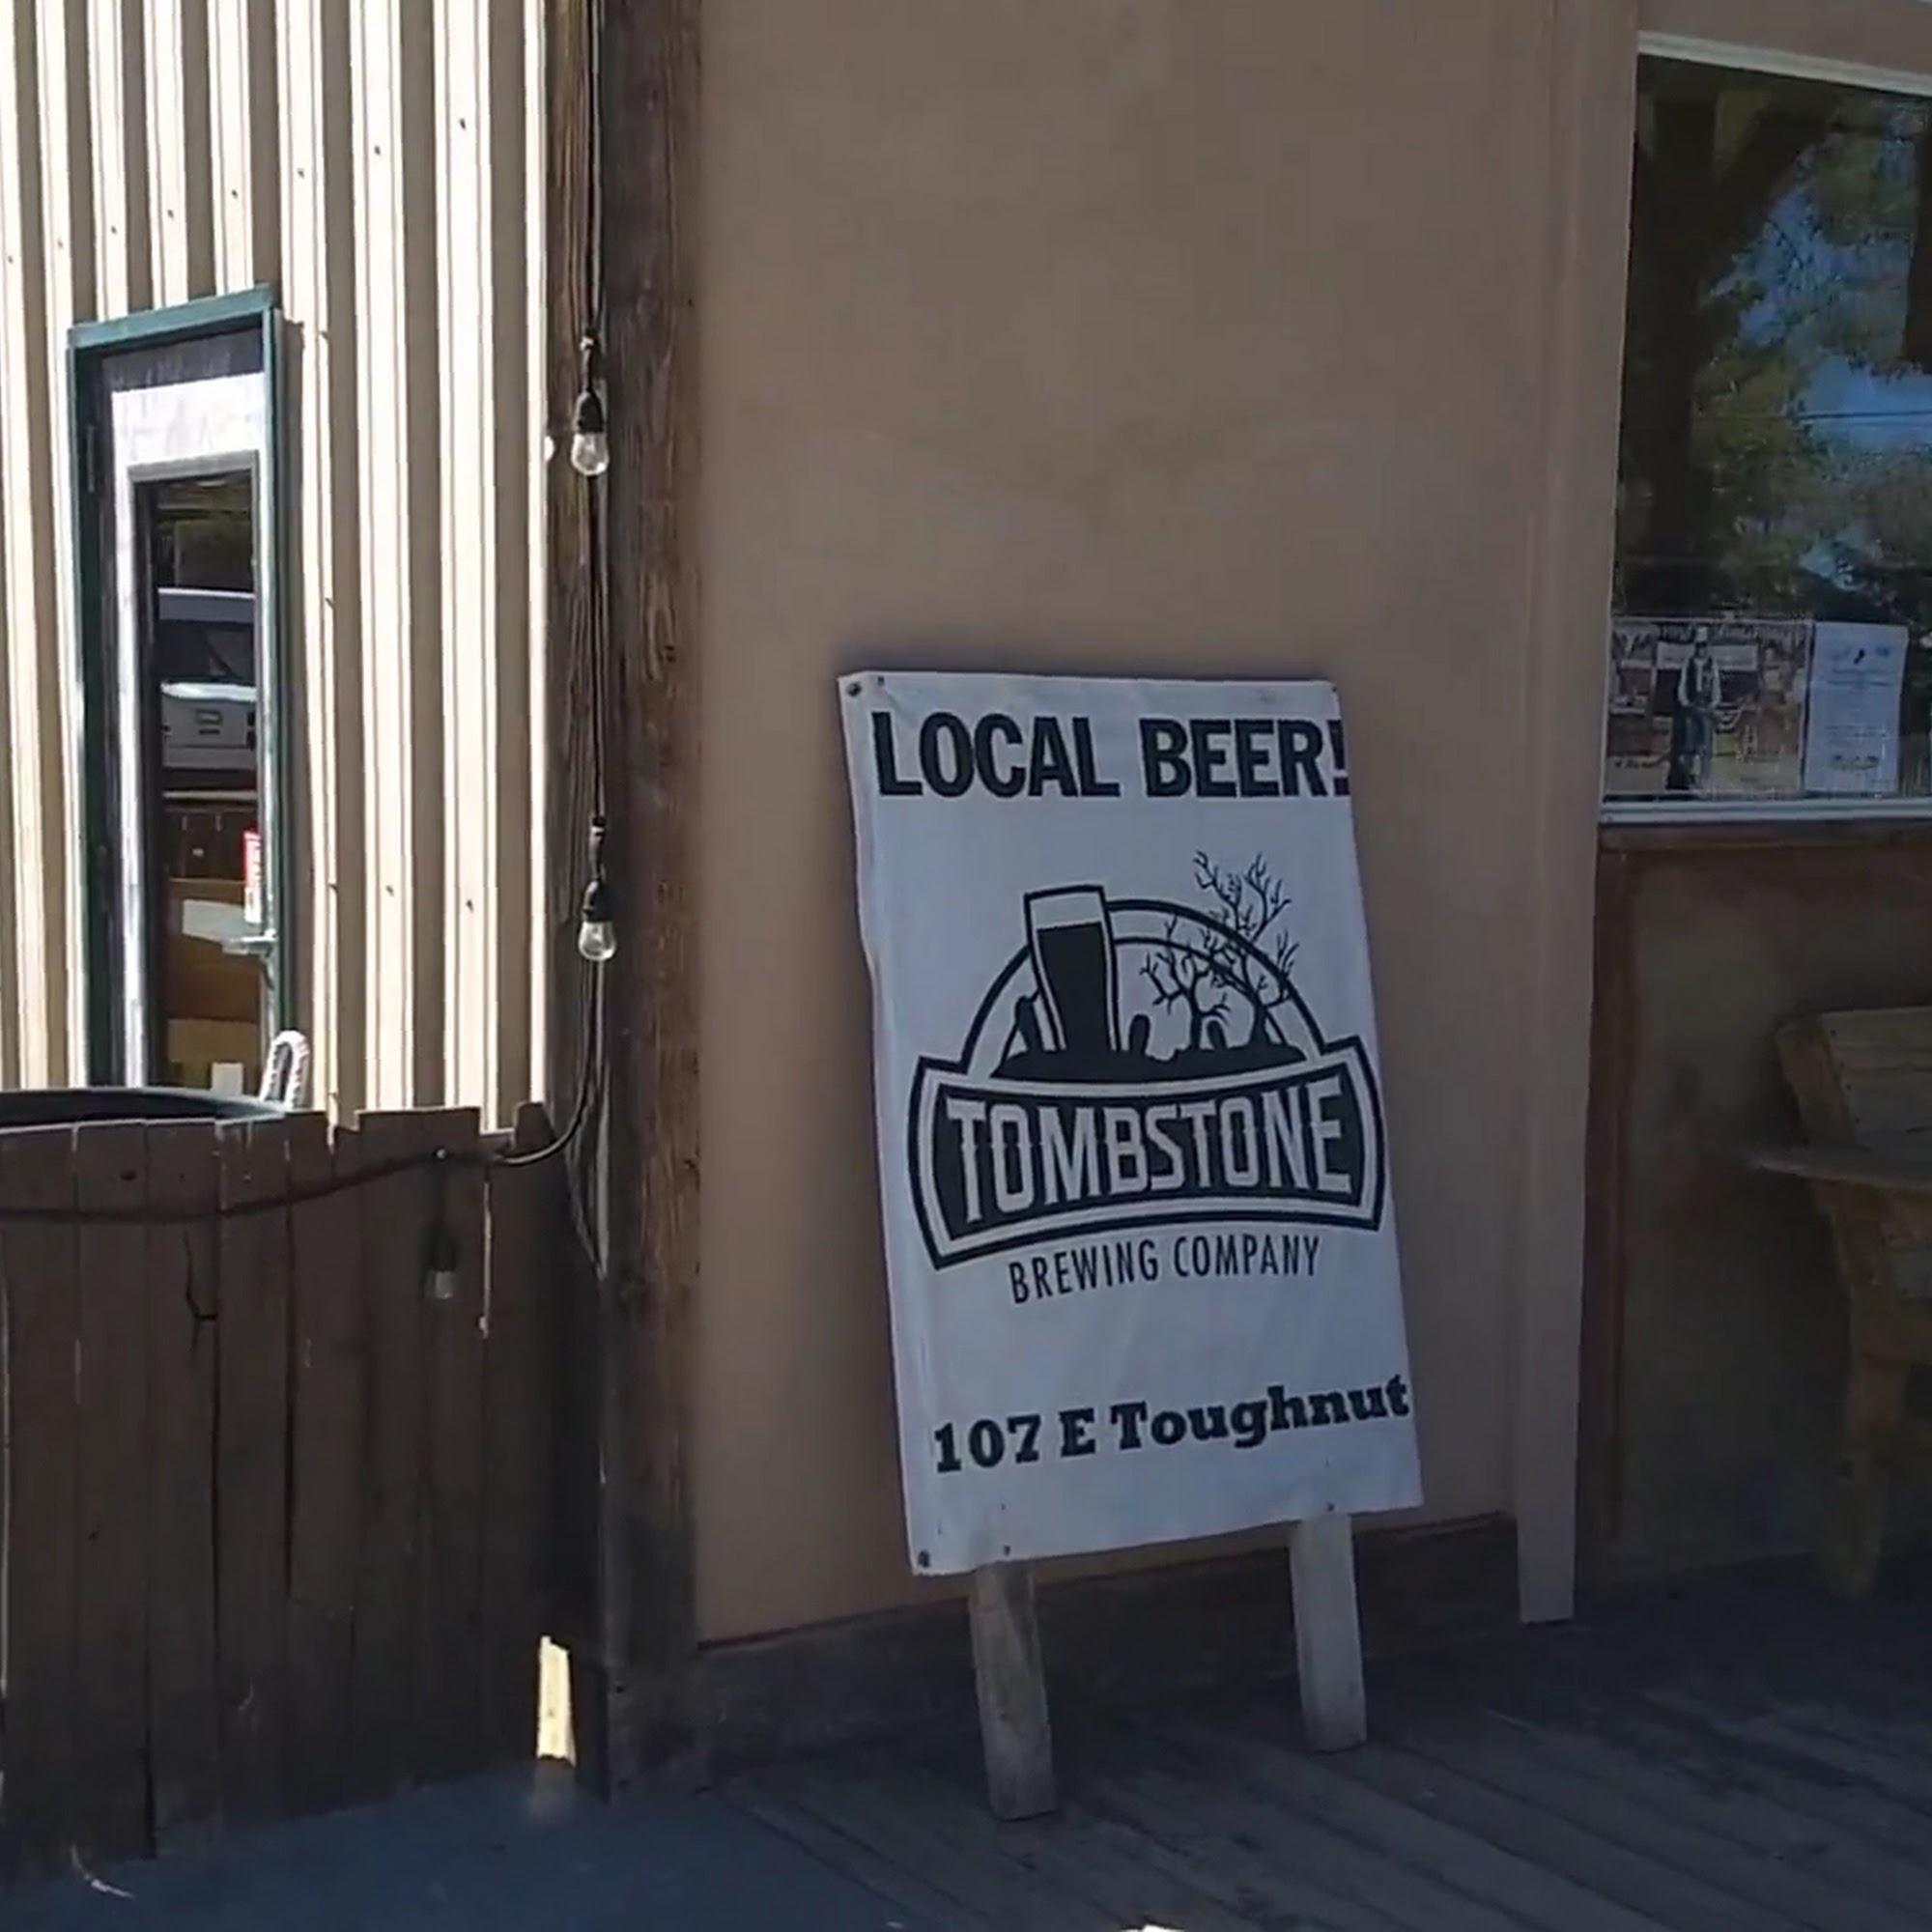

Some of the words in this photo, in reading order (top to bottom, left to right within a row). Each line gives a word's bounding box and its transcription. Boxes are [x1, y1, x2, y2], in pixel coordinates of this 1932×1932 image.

[871, 711, 1122, 798] LOCAL
[1139, 718, 1350, 798] BEER!
[945, 1075, 1351, 1223] TOMBSTONE
[1008, 1239, 1159, 1304] BREWING
[1174, 1234, 1321, 1278] COMPANY
[934, 1413, 1042, 1473] 107
[1059, 1407, 1096, 1458] E
[1110, 1375, 1410, 1448] Toughnut
